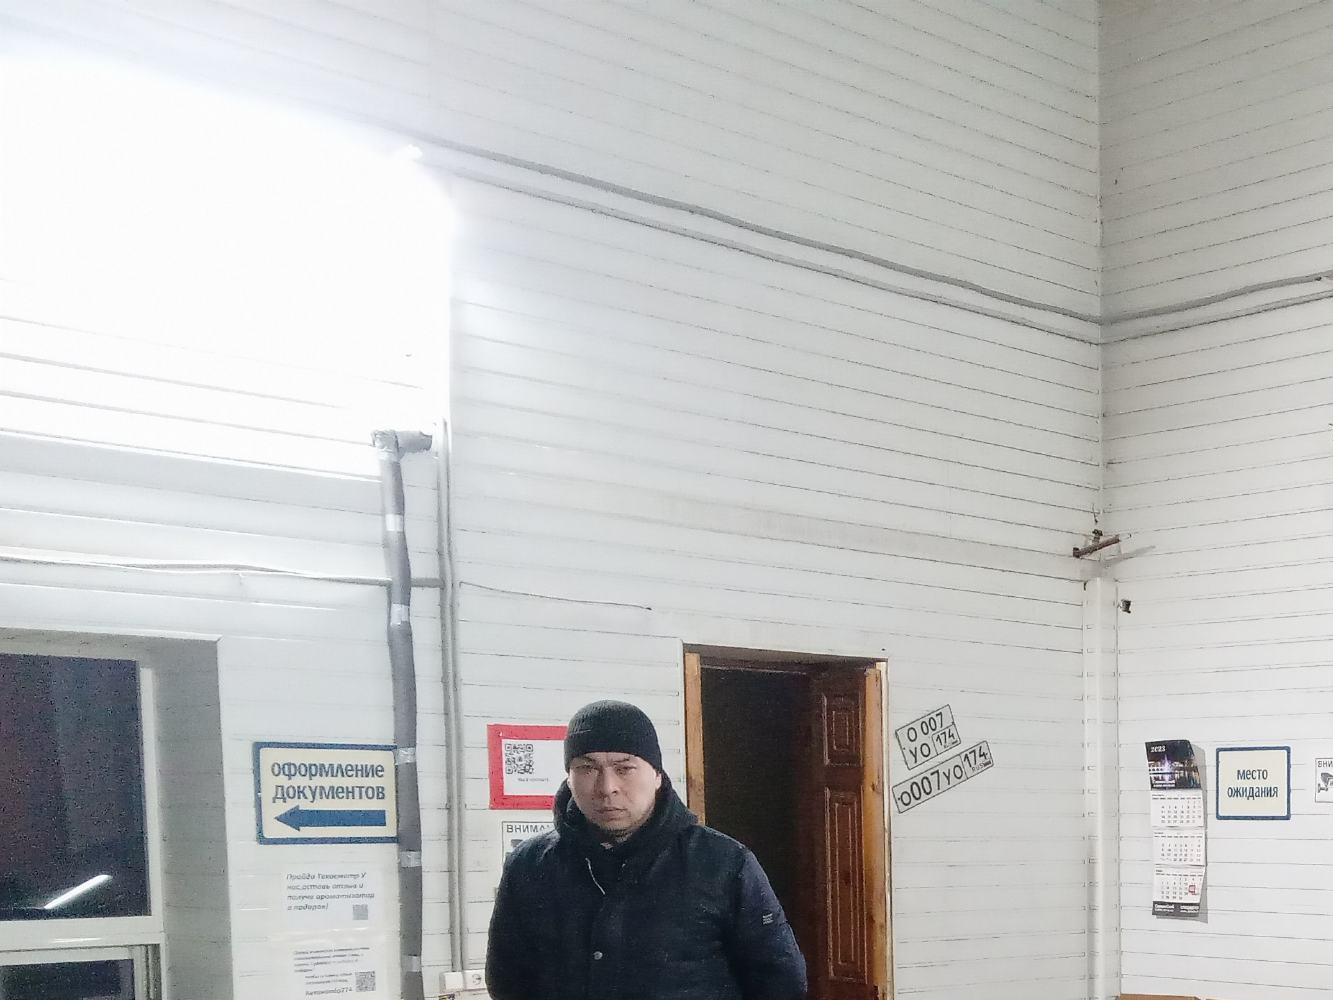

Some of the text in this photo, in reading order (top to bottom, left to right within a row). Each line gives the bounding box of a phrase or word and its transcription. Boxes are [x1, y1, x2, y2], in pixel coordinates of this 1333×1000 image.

[920, 712, 943, 736] 007
[935, 728, 956, 747] 174
[963, 746, 987, 769] 174
[271, 760, 385, 780] оформление
[1236, 768, 1269, 780] место
[272, 784, 386, 804] документов
[1227, 785, 1279, 800] ожидания
[506, 824, 549, 833] ВНИМА
